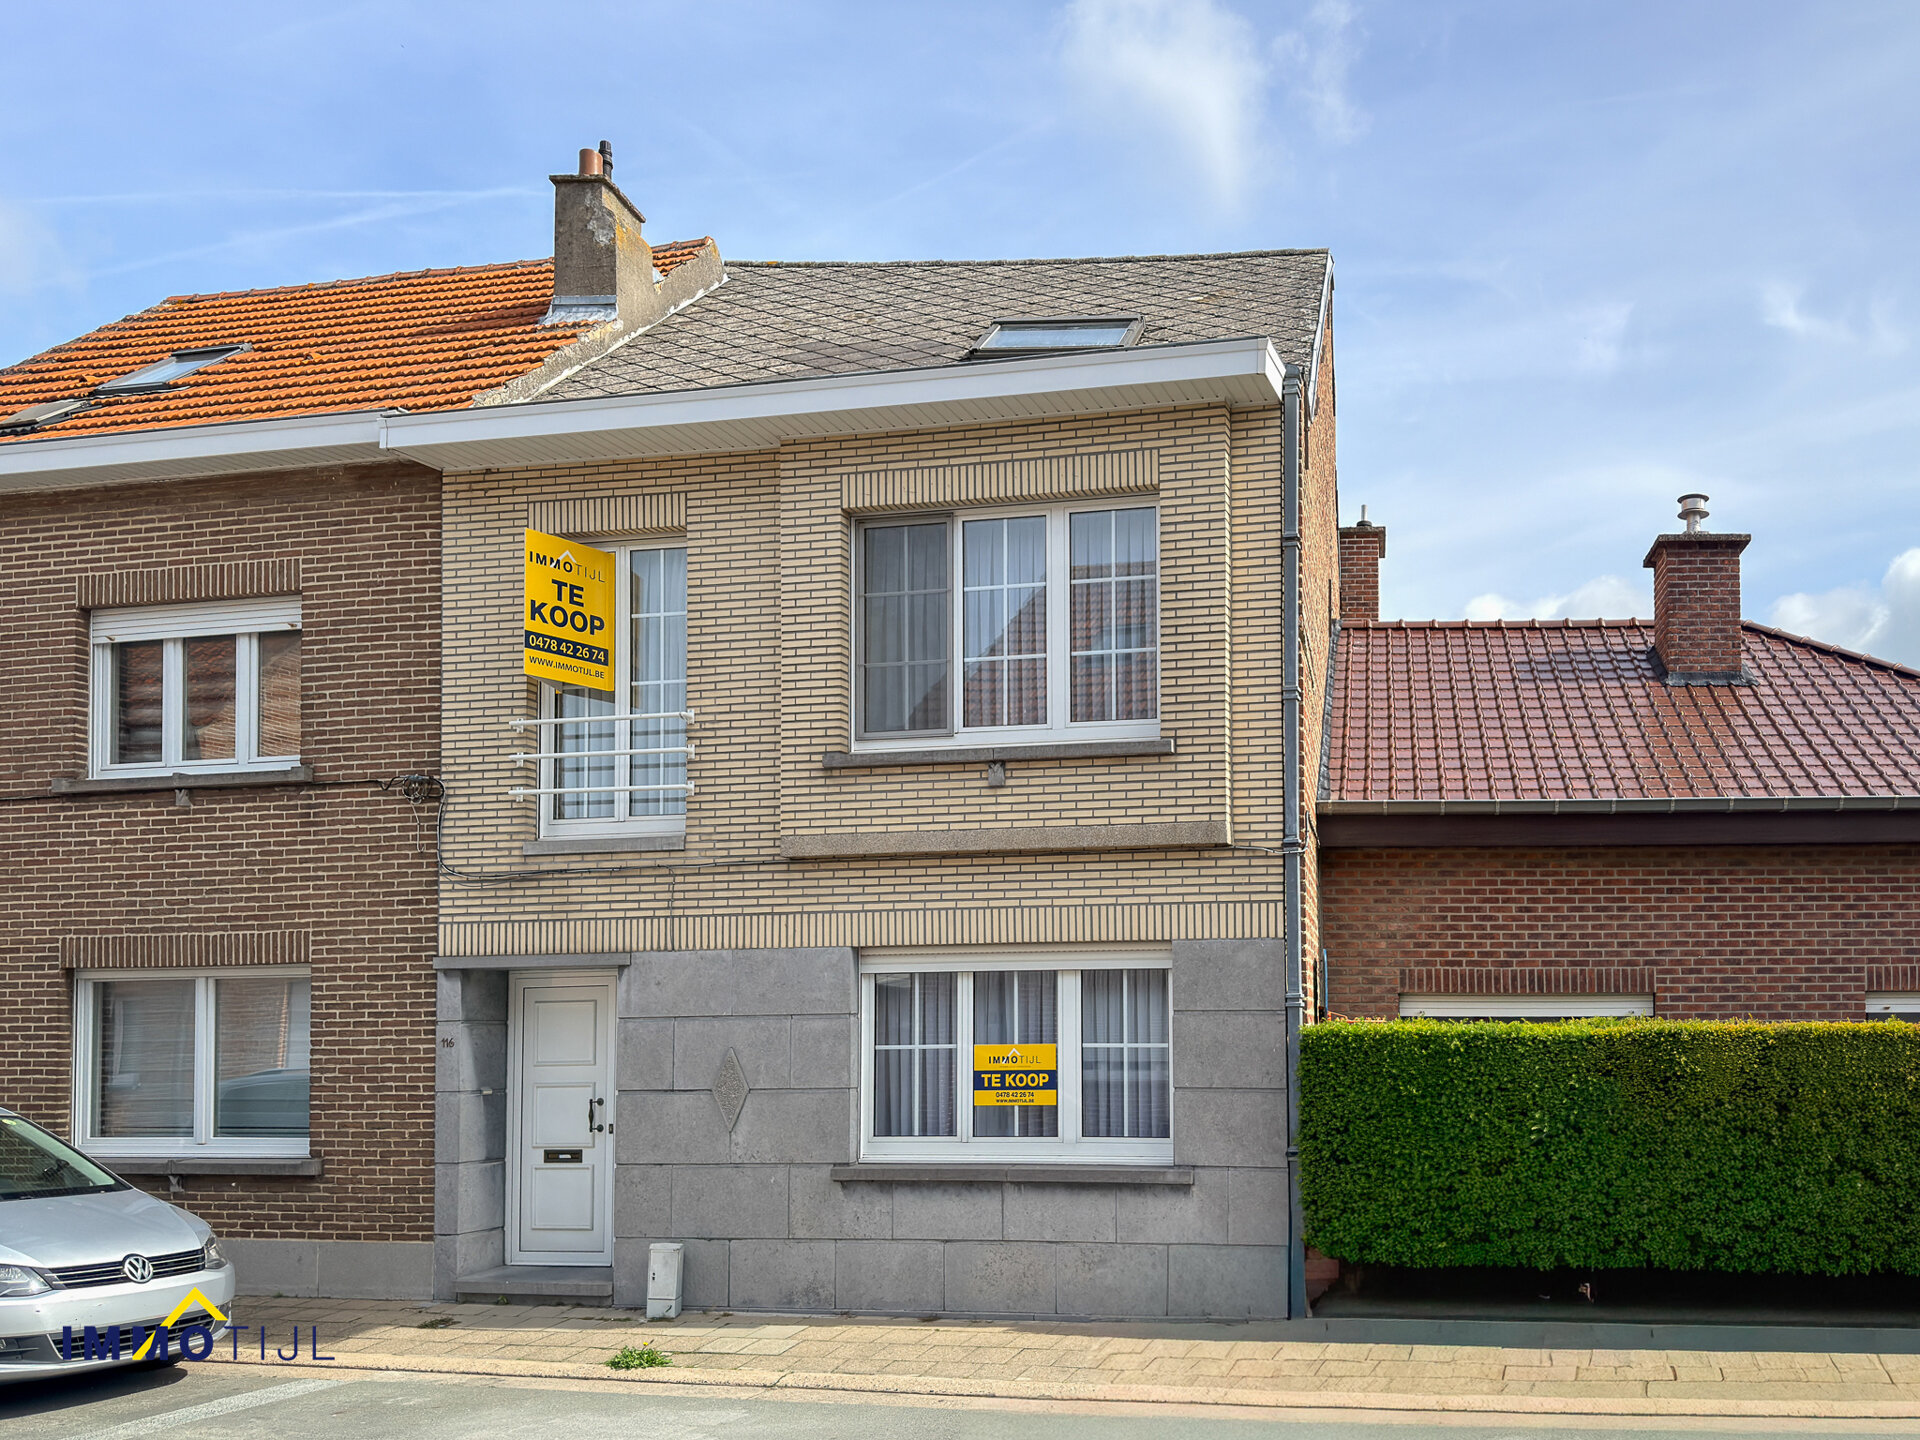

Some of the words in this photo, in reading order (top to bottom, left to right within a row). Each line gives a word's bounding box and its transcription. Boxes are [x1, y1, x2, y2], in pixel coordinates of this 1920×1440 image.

[551, 579, 584, 607] TE
[530, 599, 605, 635] KOOP
[529, 635, 558, 651] 0478
[559, 643, 574, 656] 42
[576, 645, 590, 659] 26
[591, 649, 605, 663] 74
[529, 656, 605, 679] WWW.IMMOTIJL.BE
[981, 1074, 1001, 1087] TE
[1005, 1073, 1049, 1087] KOOP
